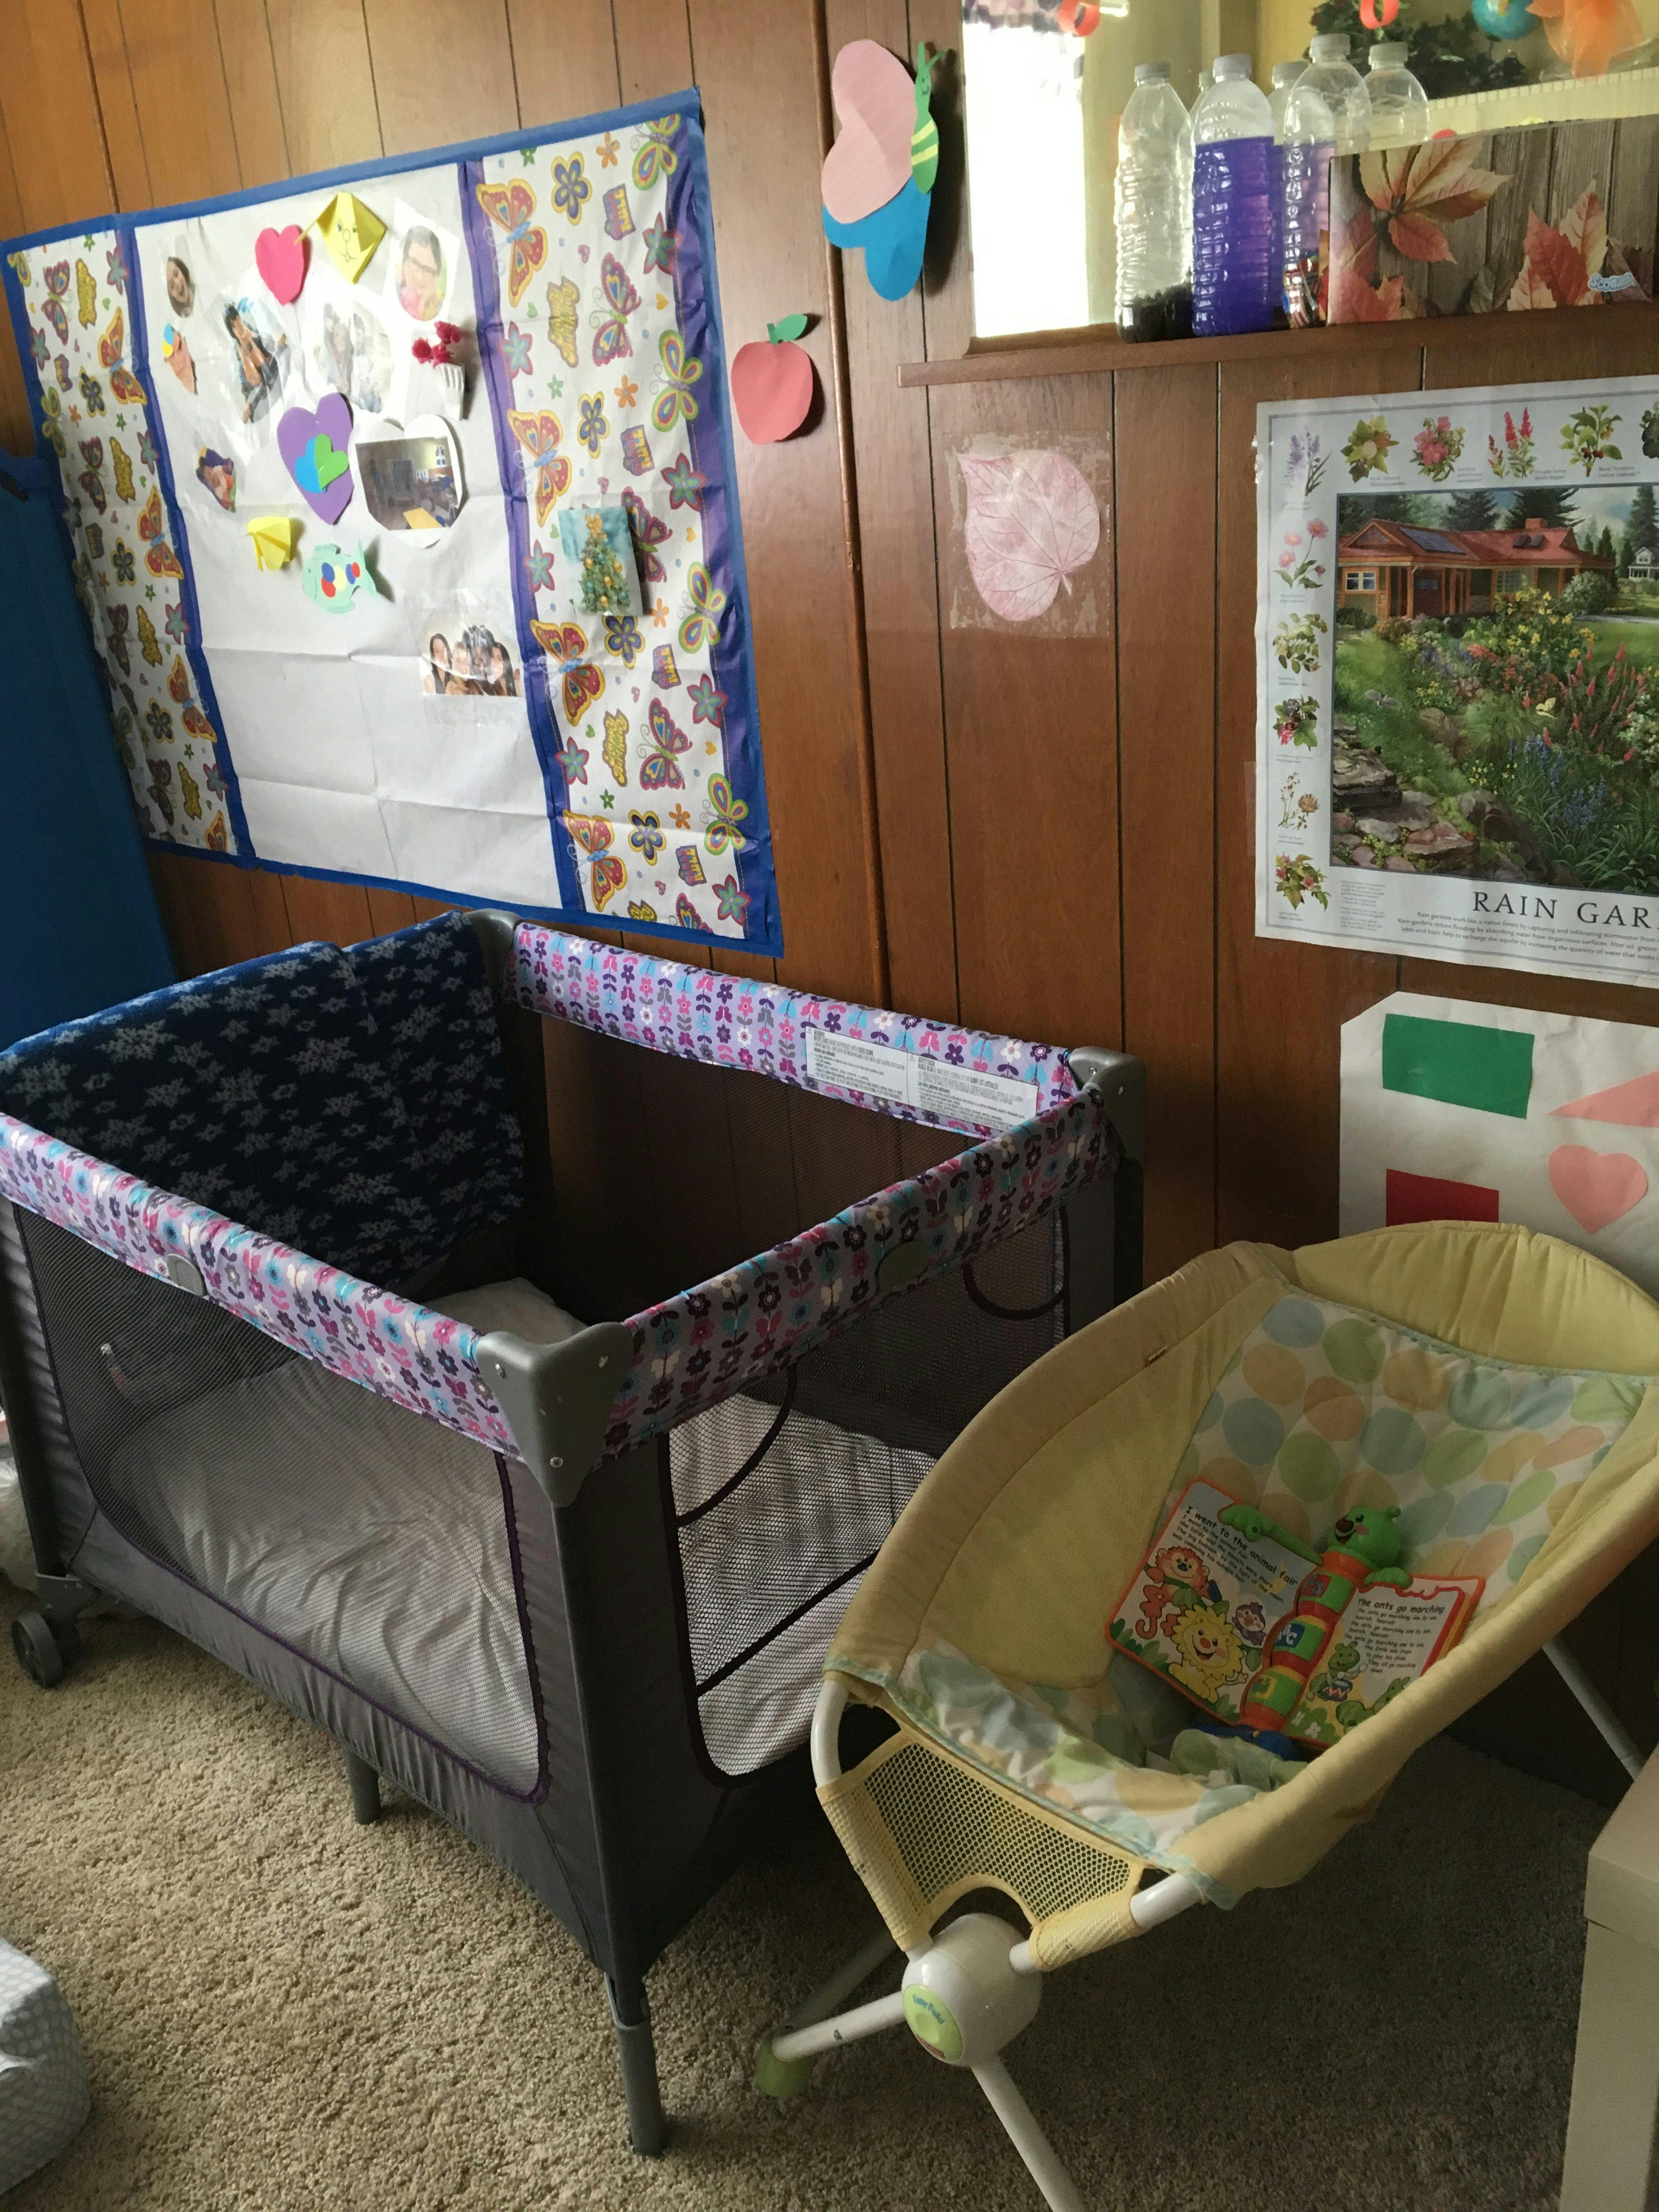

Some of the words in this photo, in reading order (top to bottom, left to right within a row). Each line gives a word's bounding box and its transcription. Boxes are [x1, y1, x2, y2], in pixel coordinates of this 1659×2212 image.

[604, 715, 616, 767] Happy
[613, 714, 627, 784] Birthday
[1472, 891, 1558, 919] RAIN
[1577, 902, 1659, 929] GAR
[1453, 924, 1475, 933] flooding
[1486, 928, 1514, 936] absorbing
[1528, 926, 1555, 934] capturing
[1570, 929, 1602, 939] infiltrating
[1528, 942, 1557, 951] increasing
[1172, 1532, 1182, 1541] was
[1184, 1540, 1205, 1556] combing
[1206, 1553, 1215, 1562] his
[1185, 1505, 1193, 1514] I
[1195, 1513, 1217, 1528] went
[1220, 1527, 1229, 1538] to
[1233, 1536, 1247, 1551] the
[1250, 1551, 1277, 1573] animal
[1279, 1571, 1298, 1585] fair
[1187, 1518, 1201, 1527] went
[1209, 1531, 1218, 1539] the
[1220, 1538, 1237, 1551] animal
[1190, 1526, 1204, 1538] birds
[1205, 1537, 1216, 1545] and
[1217, 1544, 1226, 1553] the
[1227, 1551, 1244, 1566] beasts
[1245, 1566, 1257, 1576] were
[1176, 1526, 1187, 1534] The
[1187, 1533, 1197, 1542] big
[1220, 1554, 1227, 1562] by
[1228, 1560, 1237, 1568] the
[1259, 1583, 1267, 1593] the
[1357, 1598, 1371, 1607] The
[1374, 1602, 1393, 1610] ants
[1409, 1605, 1444, 1615] marching
